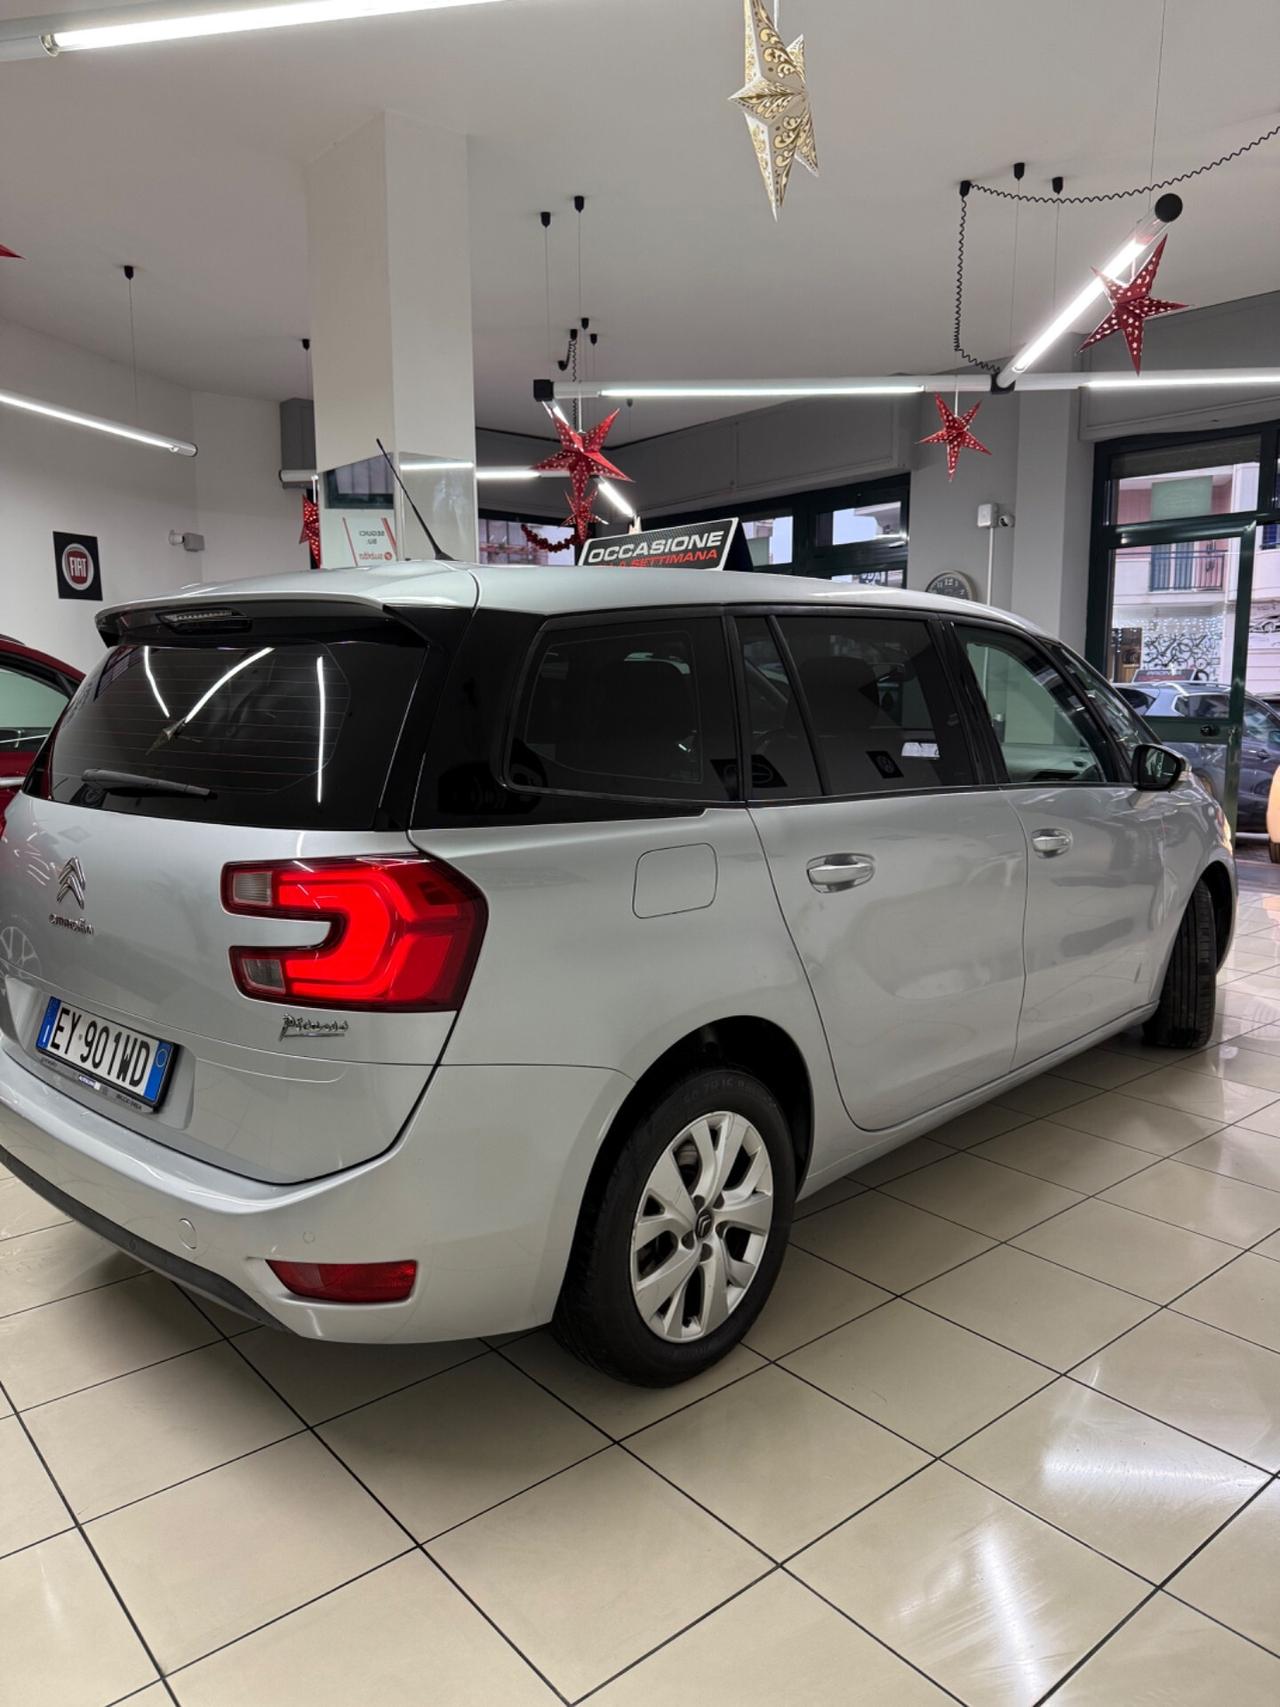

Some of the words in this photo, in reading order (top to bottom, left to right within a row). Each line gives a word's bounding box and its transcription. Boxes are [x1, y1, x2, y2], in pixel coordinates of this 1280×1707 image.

[588, 531, 724, 562] OCCASIONE
[631, 549, 718, 568] SETTIMANA
[69, 556, 87, 577] FIAT
[50, 1007, 82, 1055] EY
[80, 1020, 150, 1088] 901WD
